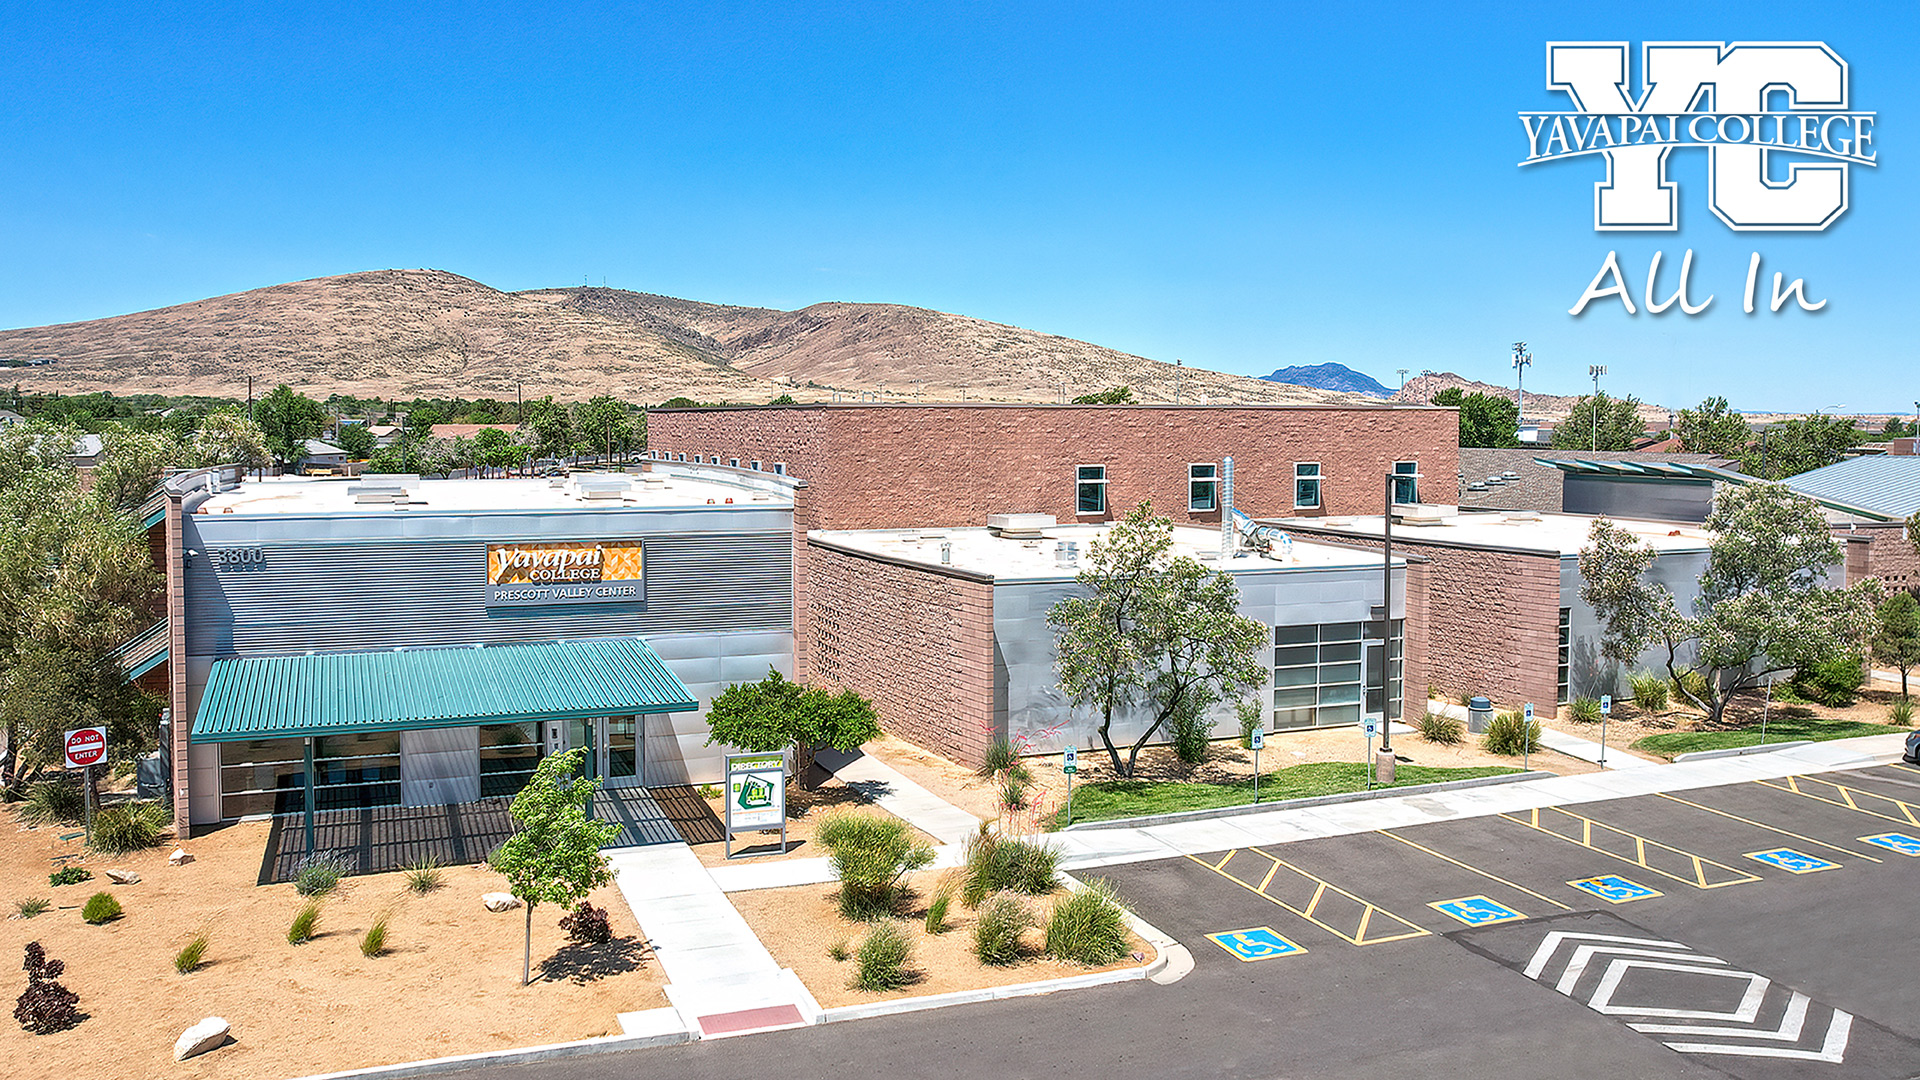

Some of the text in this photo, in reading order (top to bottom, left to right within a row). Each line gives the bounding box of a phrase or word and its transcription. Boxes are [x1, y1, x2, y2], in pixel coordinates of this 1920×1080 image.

[217, 547, 263, 564] 3800
[529, 568, 601, 581] COLLEGE
[494, 585, 636, 600] PRESCOTT VALLEY CENTER
[85, 734, 99, 742] NOT
[75, 751, 97, 760] ENTER
[731, 760, 783, 771] DIRECTORY
